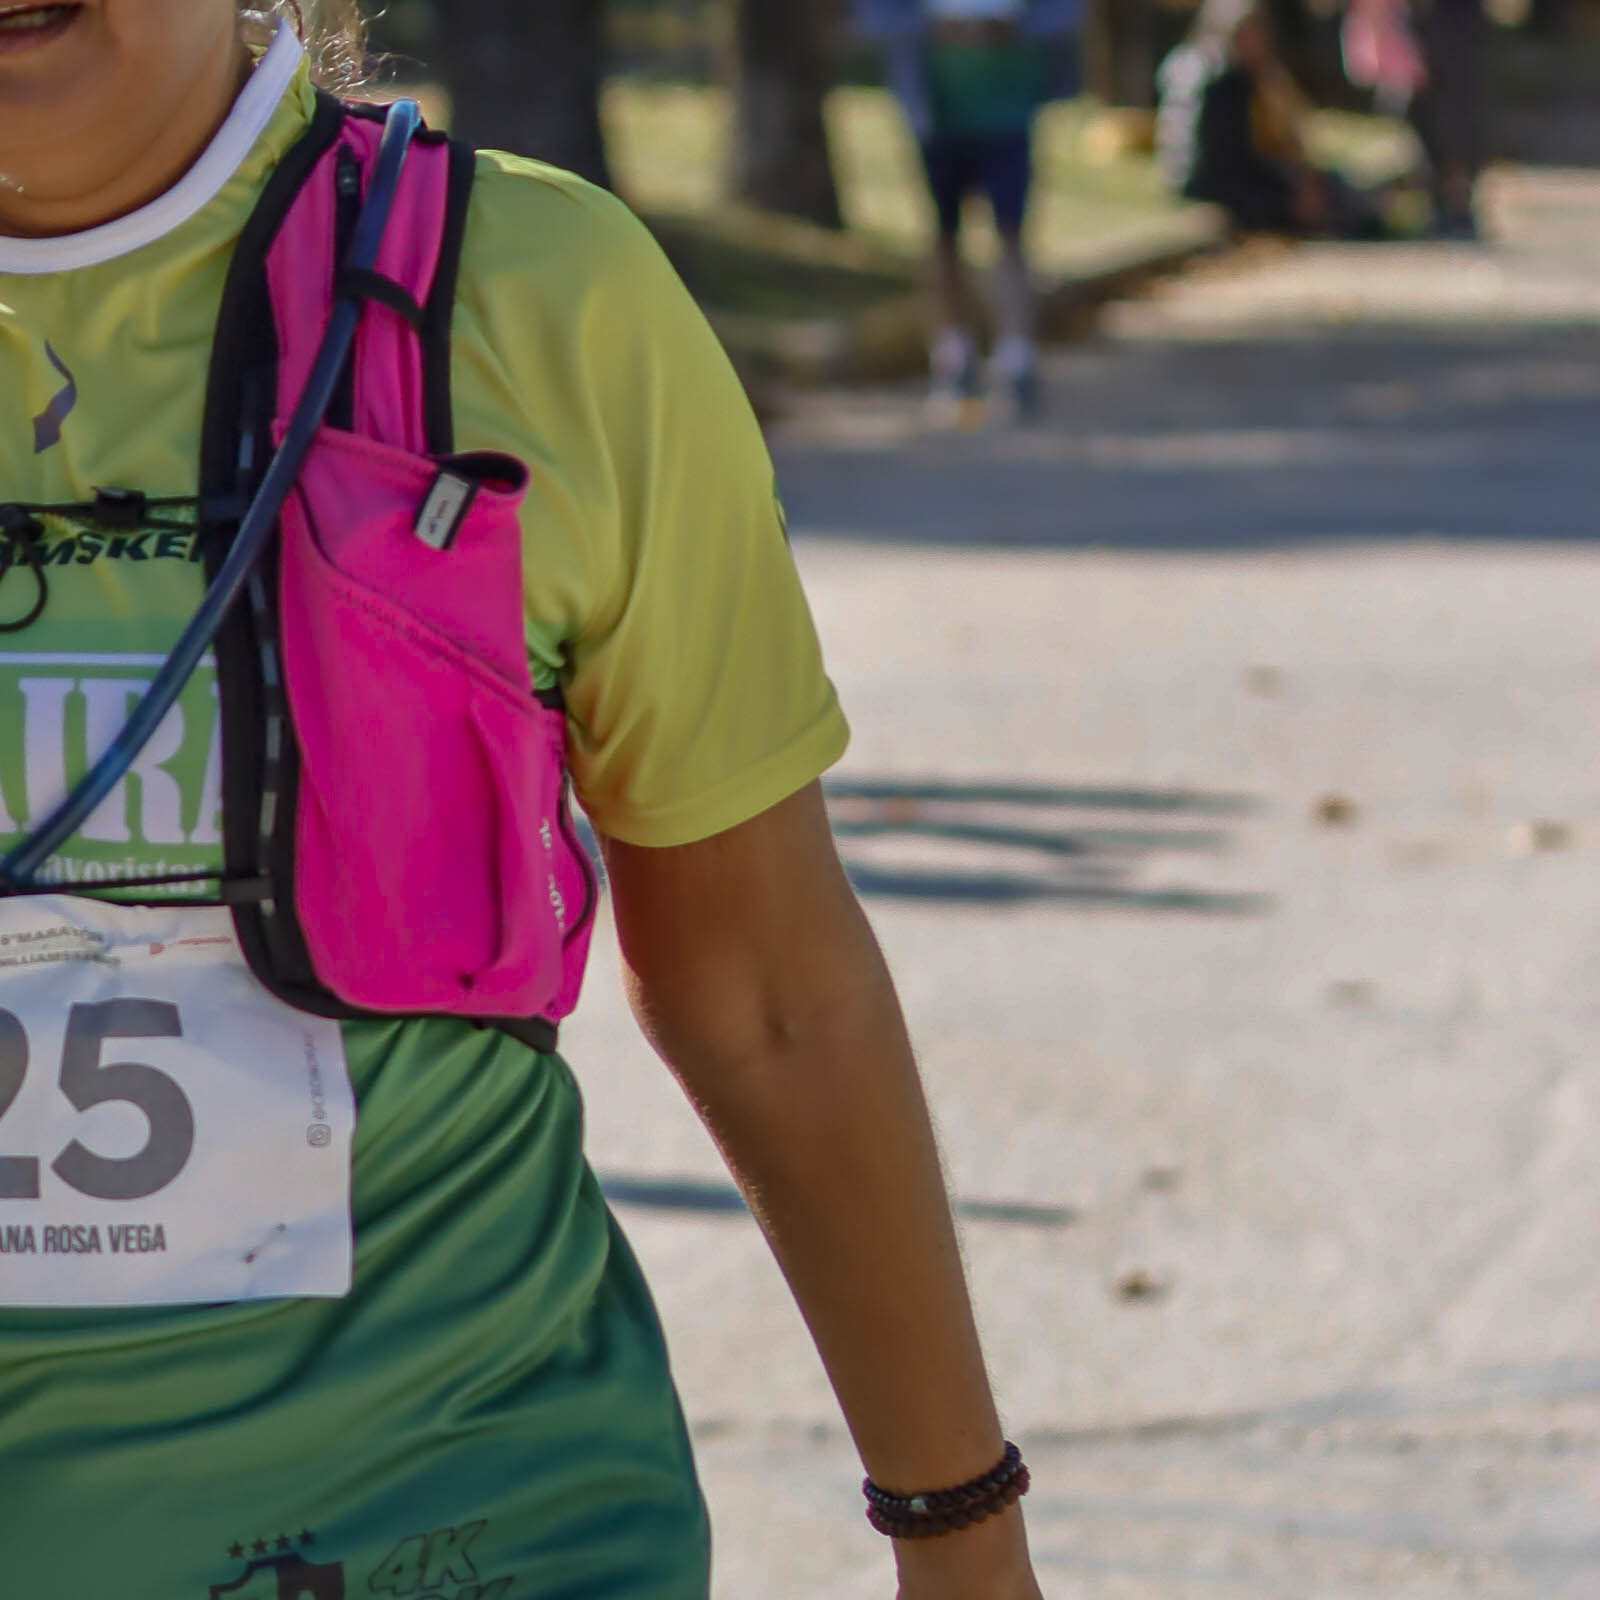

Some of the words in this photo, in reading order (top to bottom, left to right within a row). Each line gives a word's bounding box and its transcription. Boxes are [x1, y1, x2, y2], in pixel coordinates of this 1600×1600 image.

[43, 1224, 102, 1253] ROSA
[107, 1224, 167, 1252] VEGA
[368, 1518, 488, 1596] 4K
